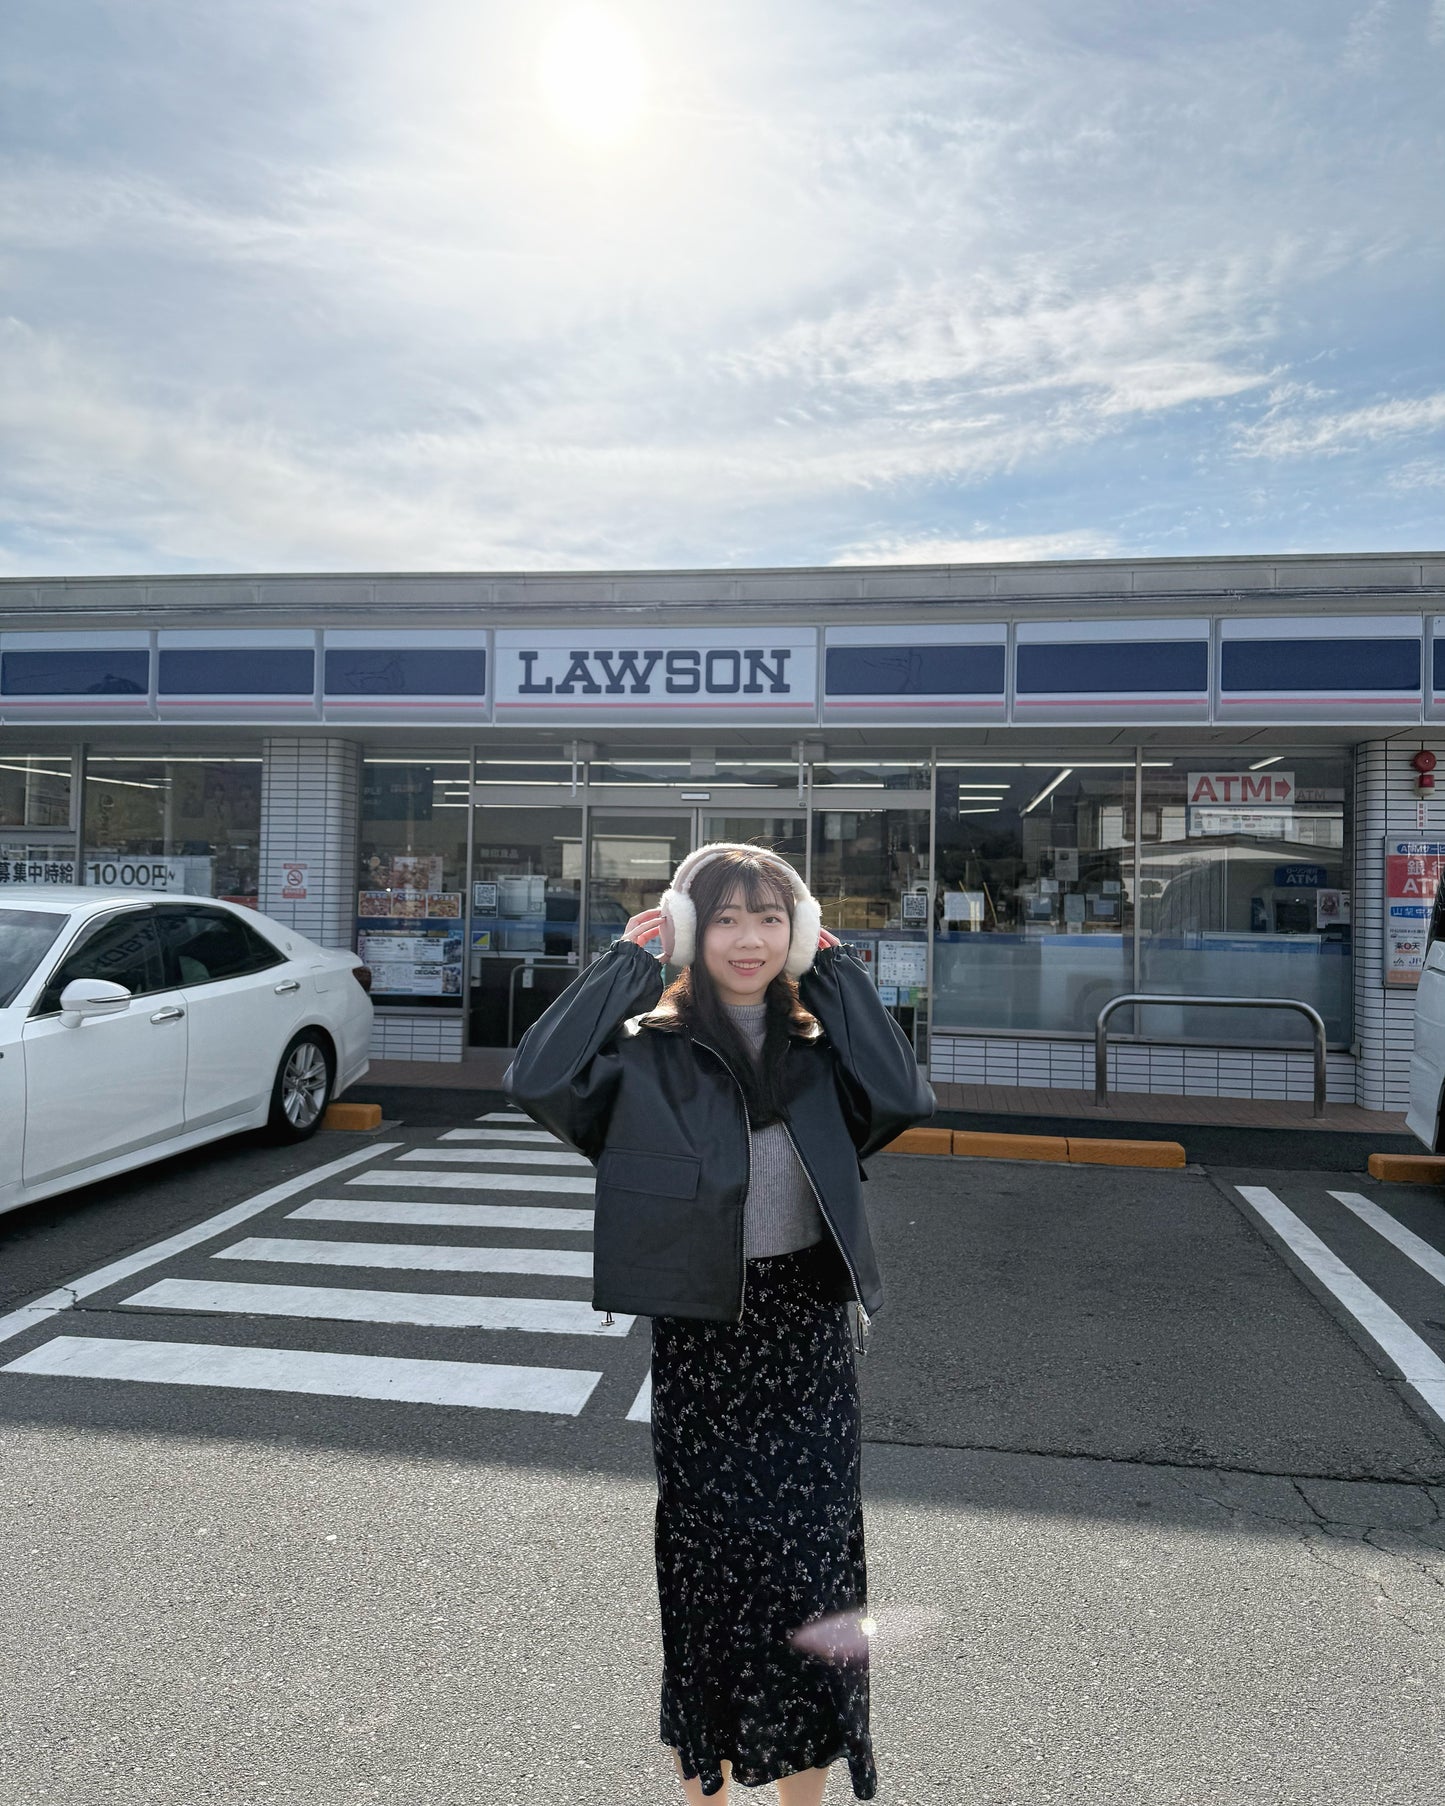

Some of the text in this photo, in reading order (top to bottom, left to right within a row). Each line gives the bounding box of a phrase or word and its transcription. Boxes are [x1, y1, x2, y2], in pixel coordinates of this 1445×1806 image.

[518, 649, 791, 694] LAWSON
[1191, 775, 1271, 802] ATM
[1286, 874, 1318, 884] ATM
